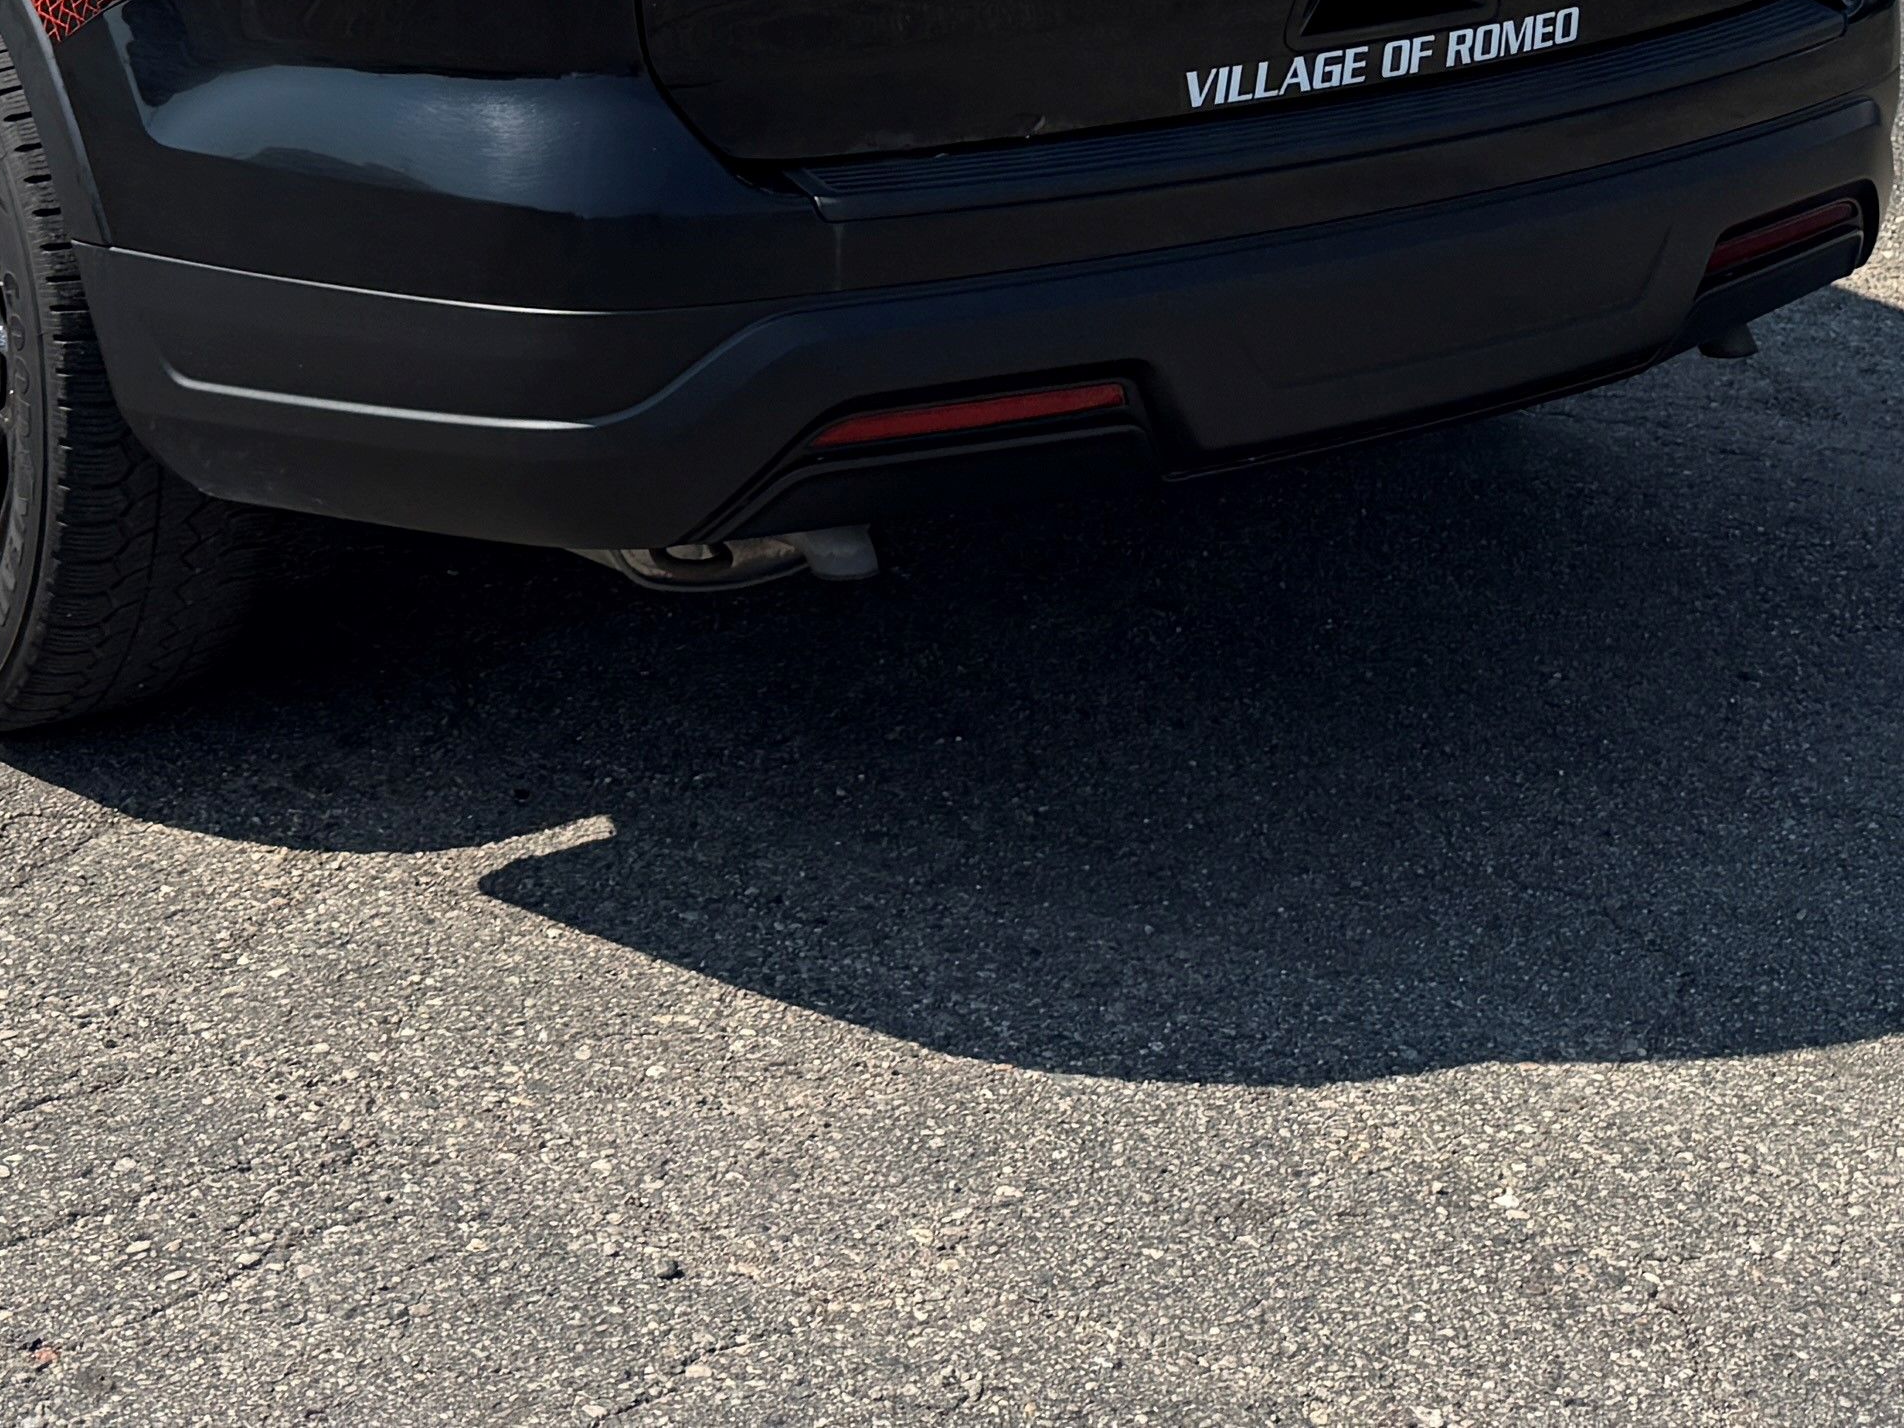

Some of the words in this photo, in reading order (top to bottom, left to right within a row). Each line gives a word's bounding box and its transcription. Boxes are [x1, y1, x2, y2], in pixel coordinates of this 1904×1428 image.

[1186, 46, 1369, 107] VILLAGE
[1381, 34, 1435, 79] OF
[1445, 6, 1580, 68] ROMEO
